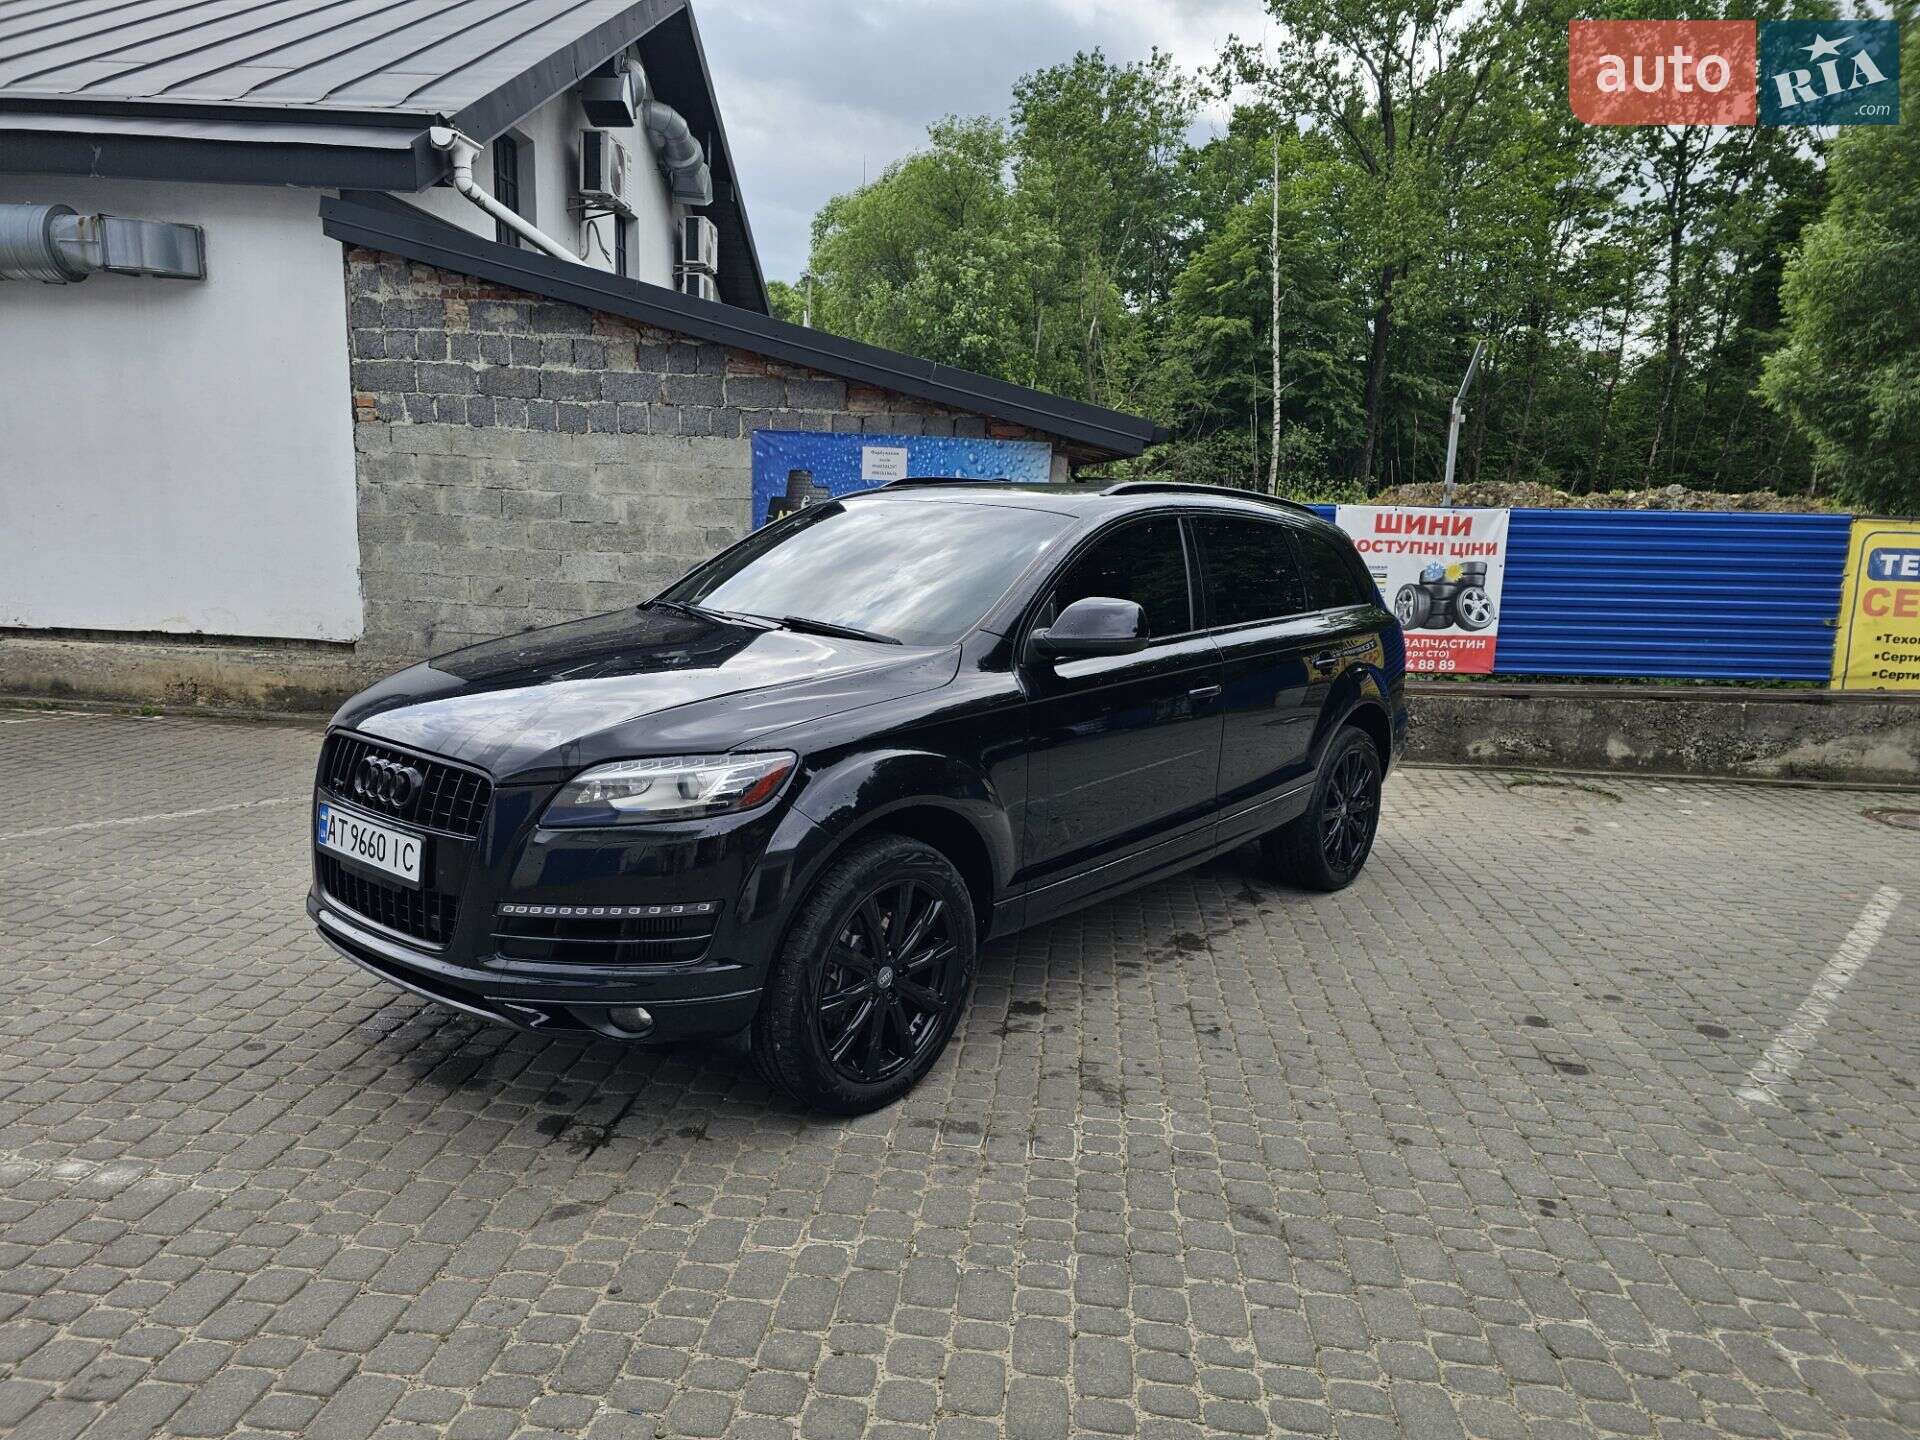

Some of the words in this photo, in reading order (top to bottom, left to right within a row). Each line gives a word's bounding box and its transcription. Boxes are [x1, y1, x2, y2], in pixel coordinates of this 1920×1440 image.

[1374, 513, 1473, 537] ШИНИ
[1354, 539, 1444, 556] ОСТУПНІ
[1450, 542, 1499, 558] ЦІНИ
[1418, 659, 1436, 670] 88
[1438, 660, 1456, 671] 89
[327, 814, 348, 847] AT
[351, 824, 386, 862] 9660
[394, 838, 415, 872] IC
